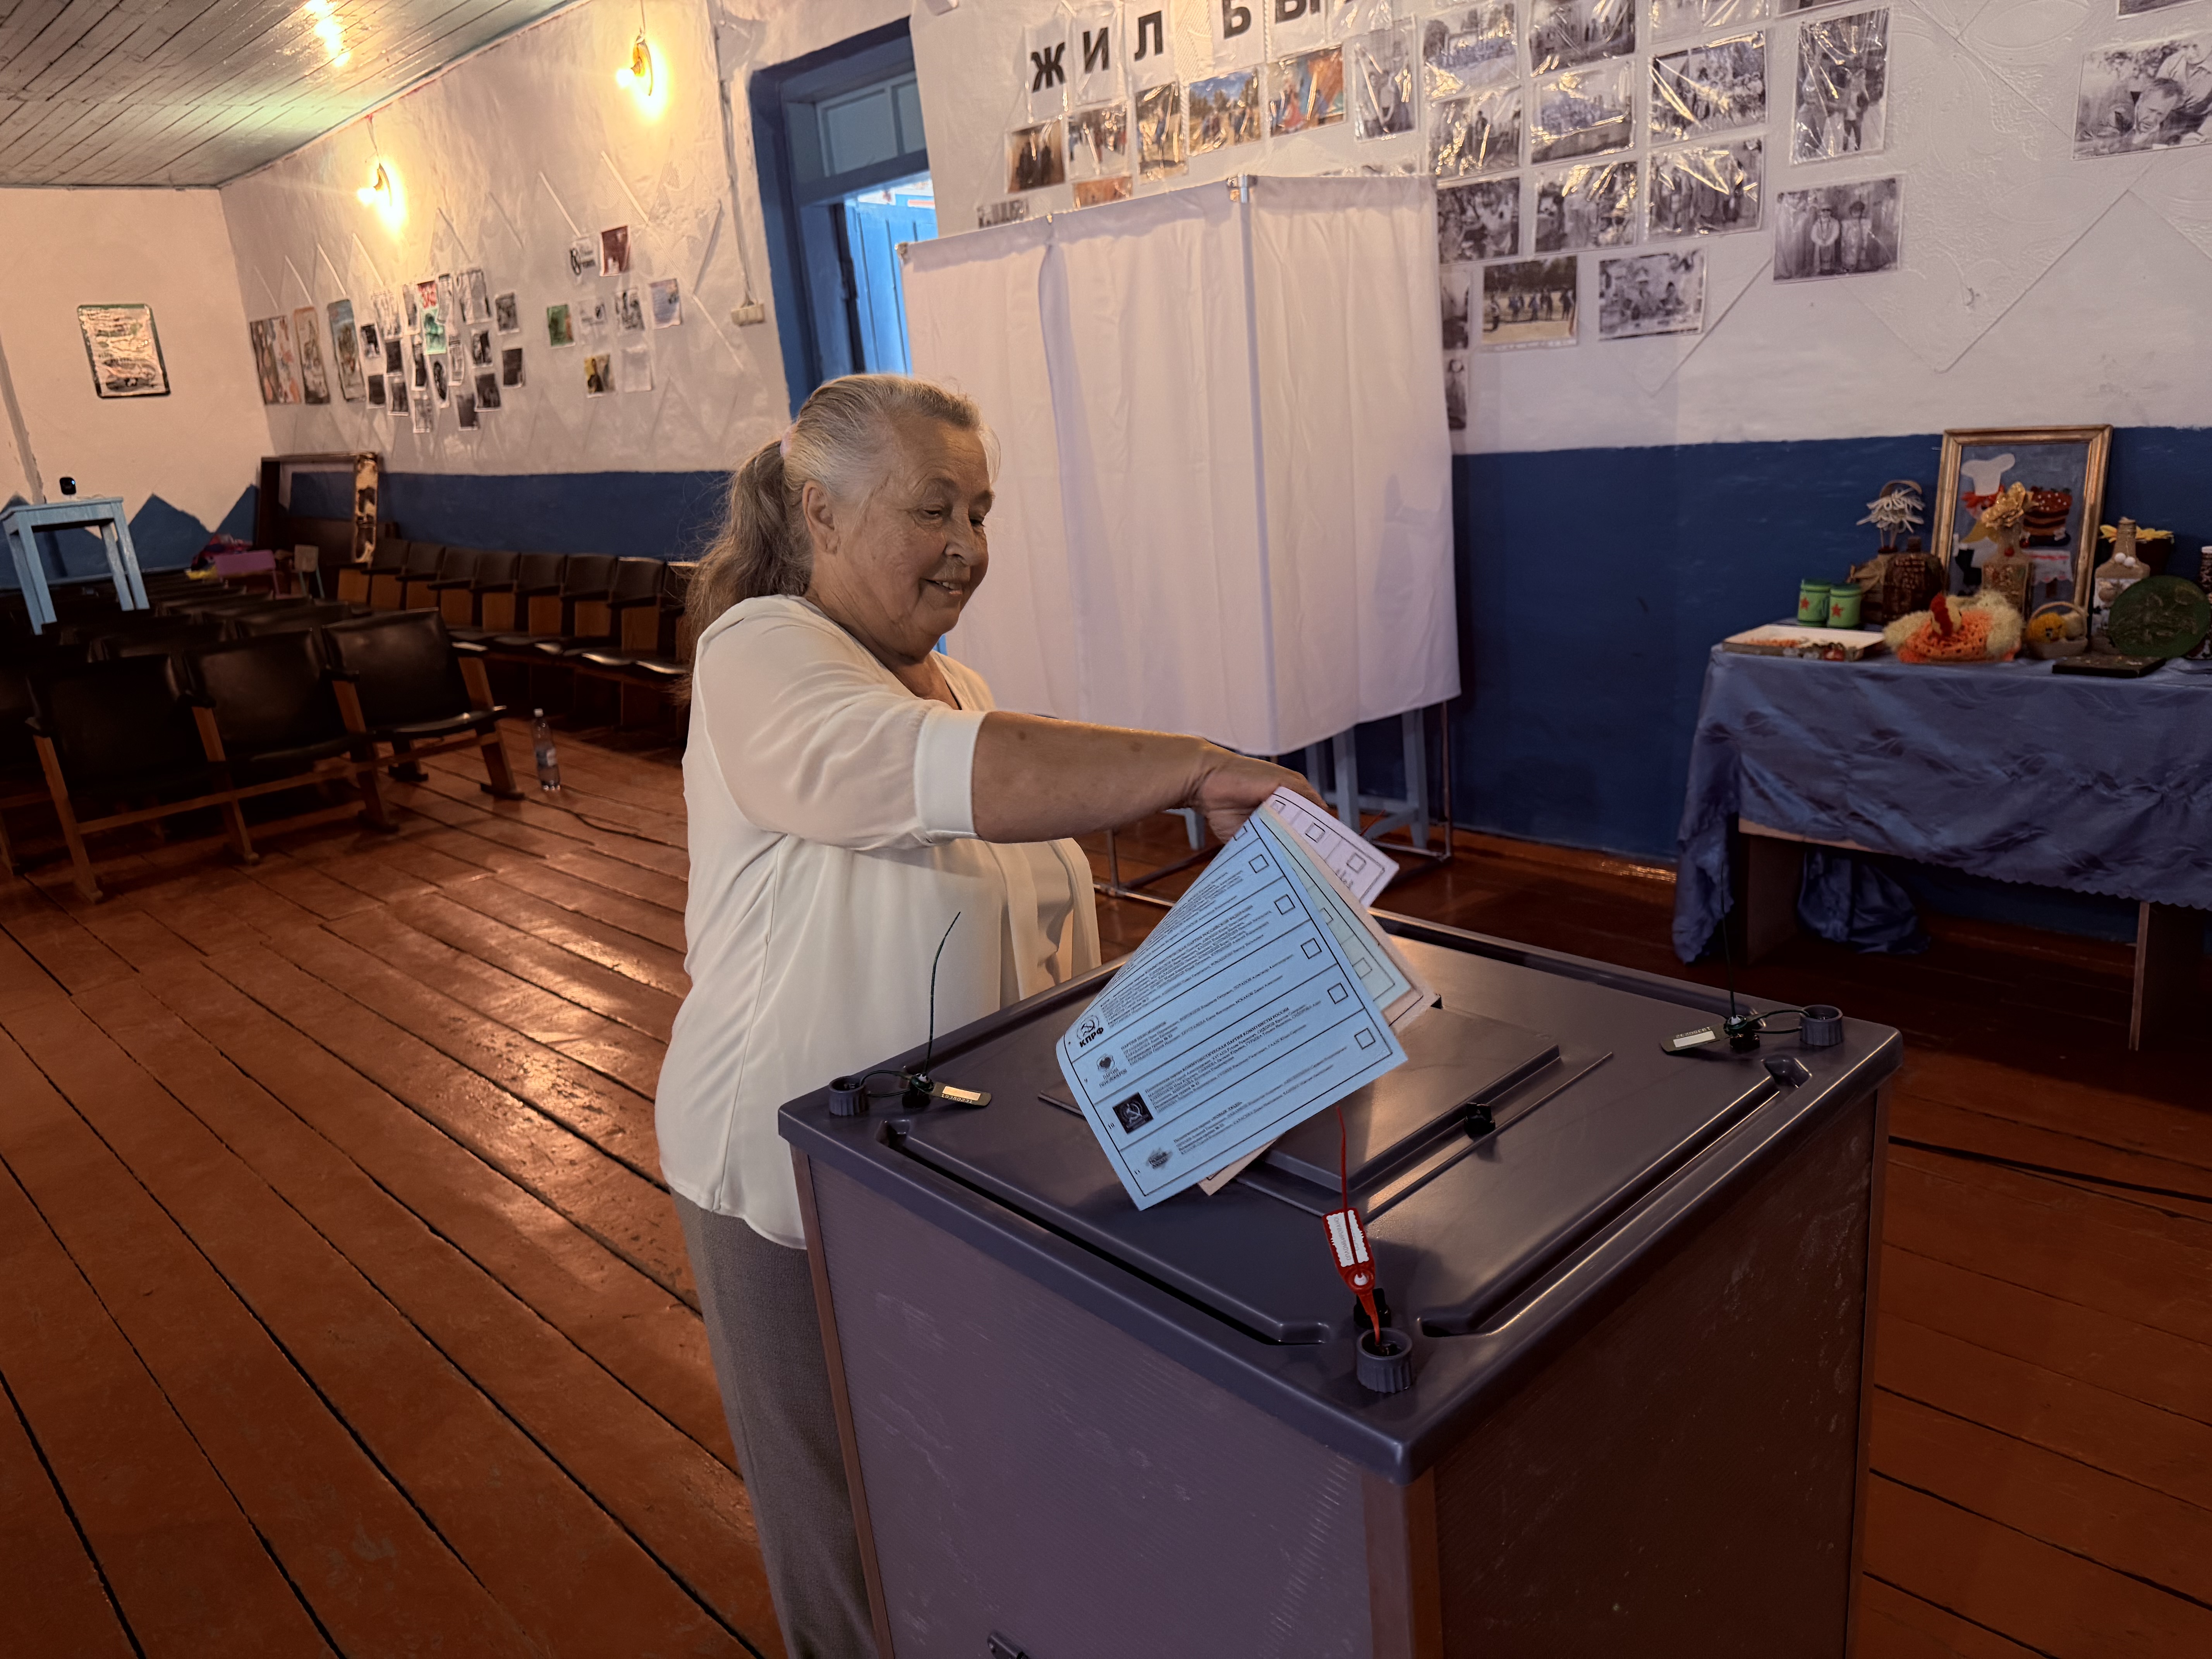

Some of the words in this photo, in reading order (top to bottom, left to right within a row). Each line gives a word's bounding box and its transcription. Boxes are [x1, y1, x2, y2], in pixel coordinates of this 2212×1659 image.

[1031, 10, 1163, 93] ЖИЛ
[1078, 1026, 1105, 1048] КПРФ
[1226, 1034, 1243, 1046] ПАРТИЯ
[1272, 1006, 1290, 1019] РОССИИ
